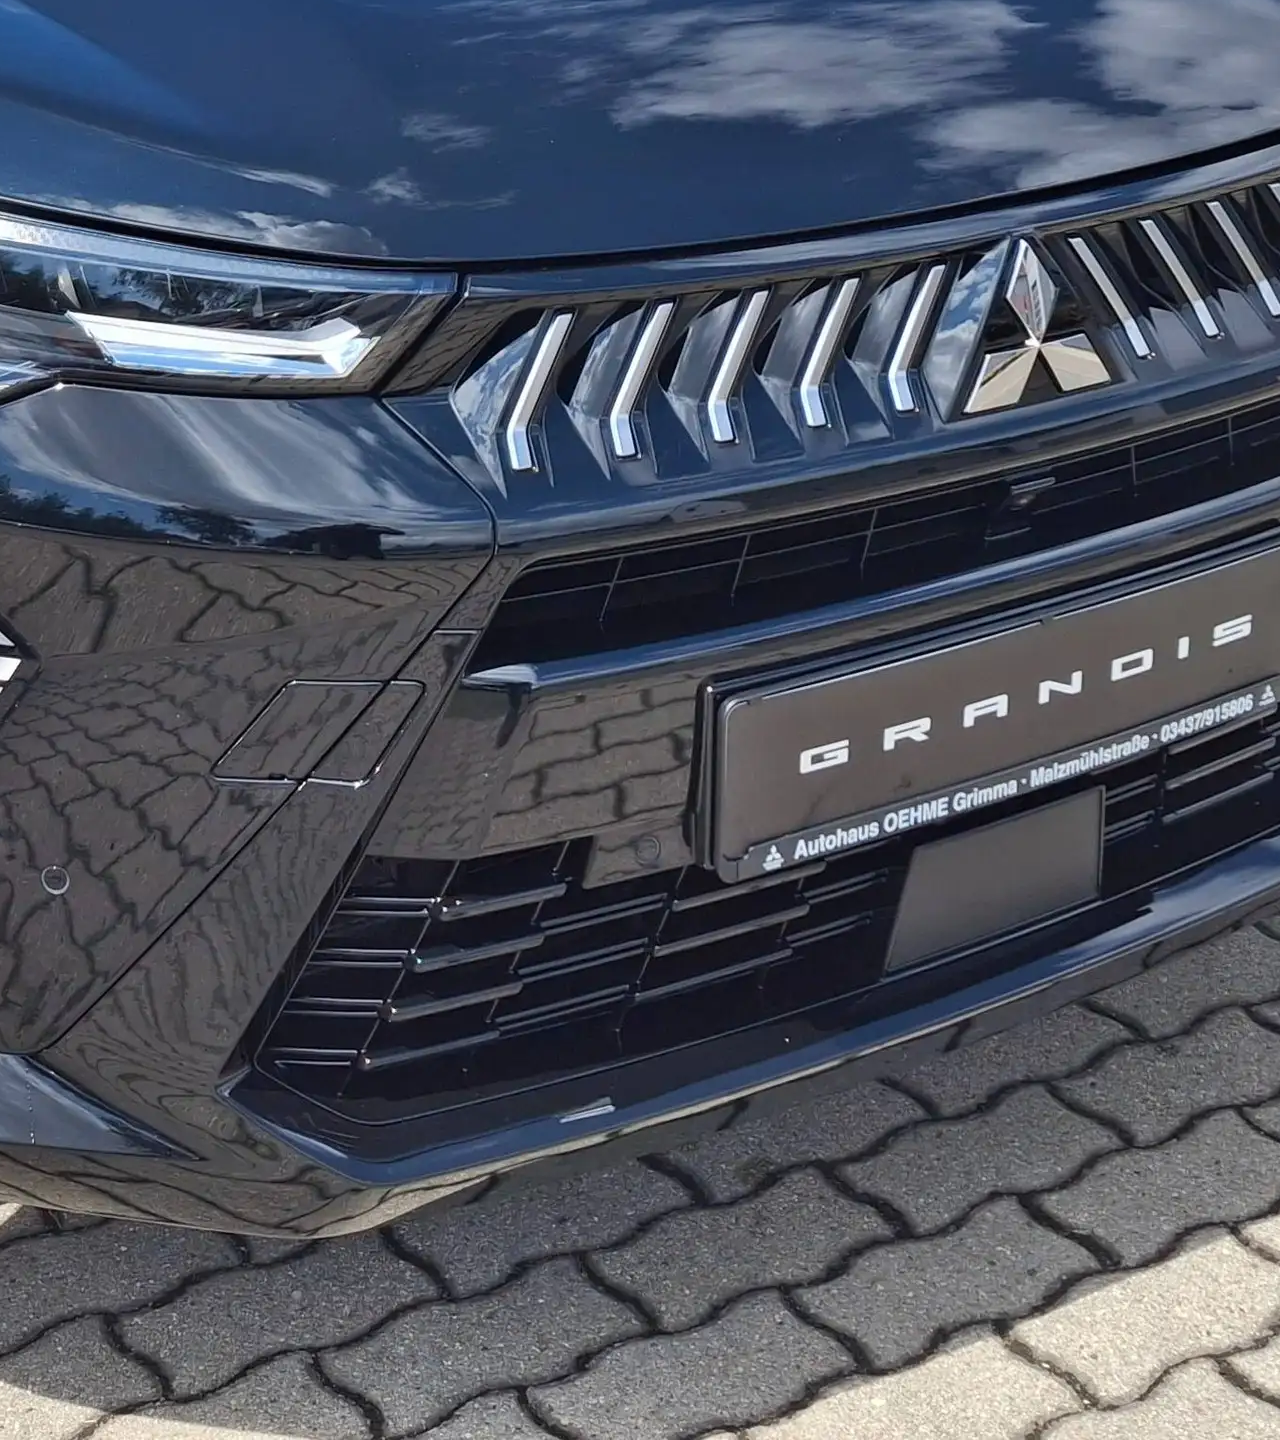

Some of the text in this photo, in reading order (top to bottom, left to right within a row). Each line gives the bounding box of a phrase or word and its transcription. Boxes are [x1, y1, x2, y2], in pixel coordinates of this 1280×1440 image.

[799, 614, 1253, 774] GRANDIS
[793, 821, 880, 860] Autohaus
[883, 796, 949, 833] OEHME
[953, 779, 1018, 812] Grimma
[1030, 734, 1150, 788] Malzmühlstraße
[1160, 693, 1254, 743] 03437/915806
